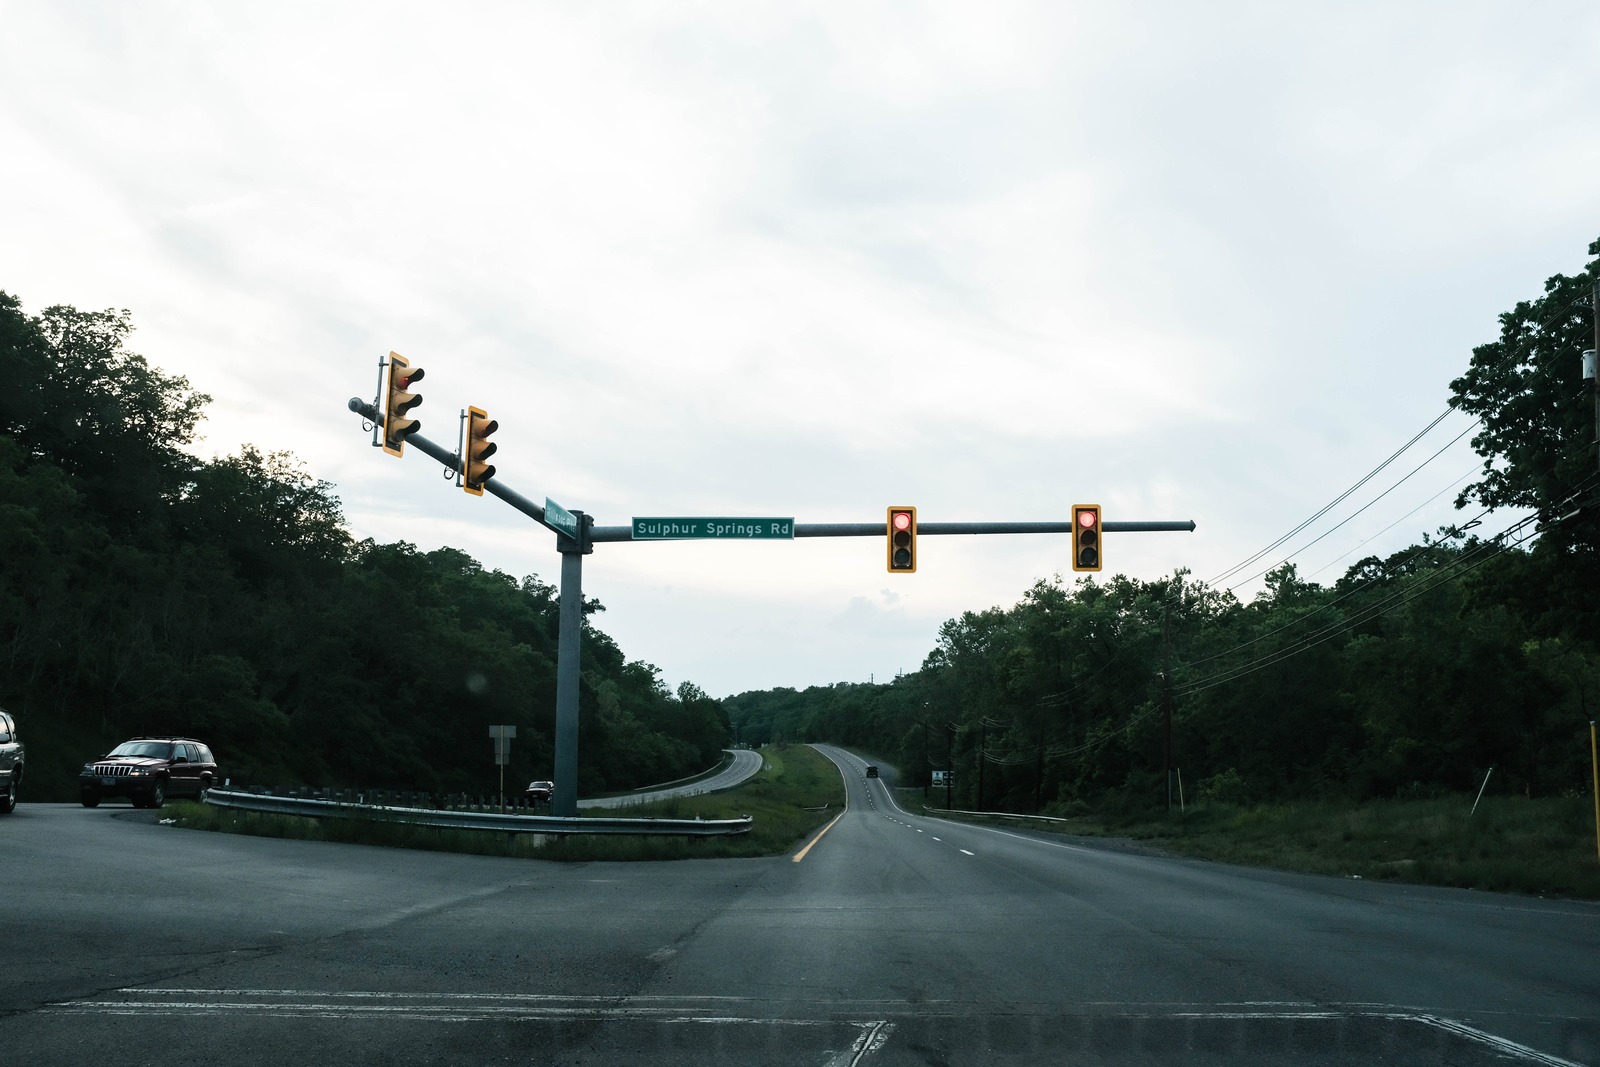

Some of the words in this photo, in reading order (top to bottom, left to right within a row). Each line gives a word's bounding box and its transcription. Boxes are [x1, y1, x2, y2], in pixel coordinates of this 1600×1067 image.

[638, 522, 697, 536] Sulphur
[706, 522, 762, 536] Springs
[771, 522, 789, 534] Rd
